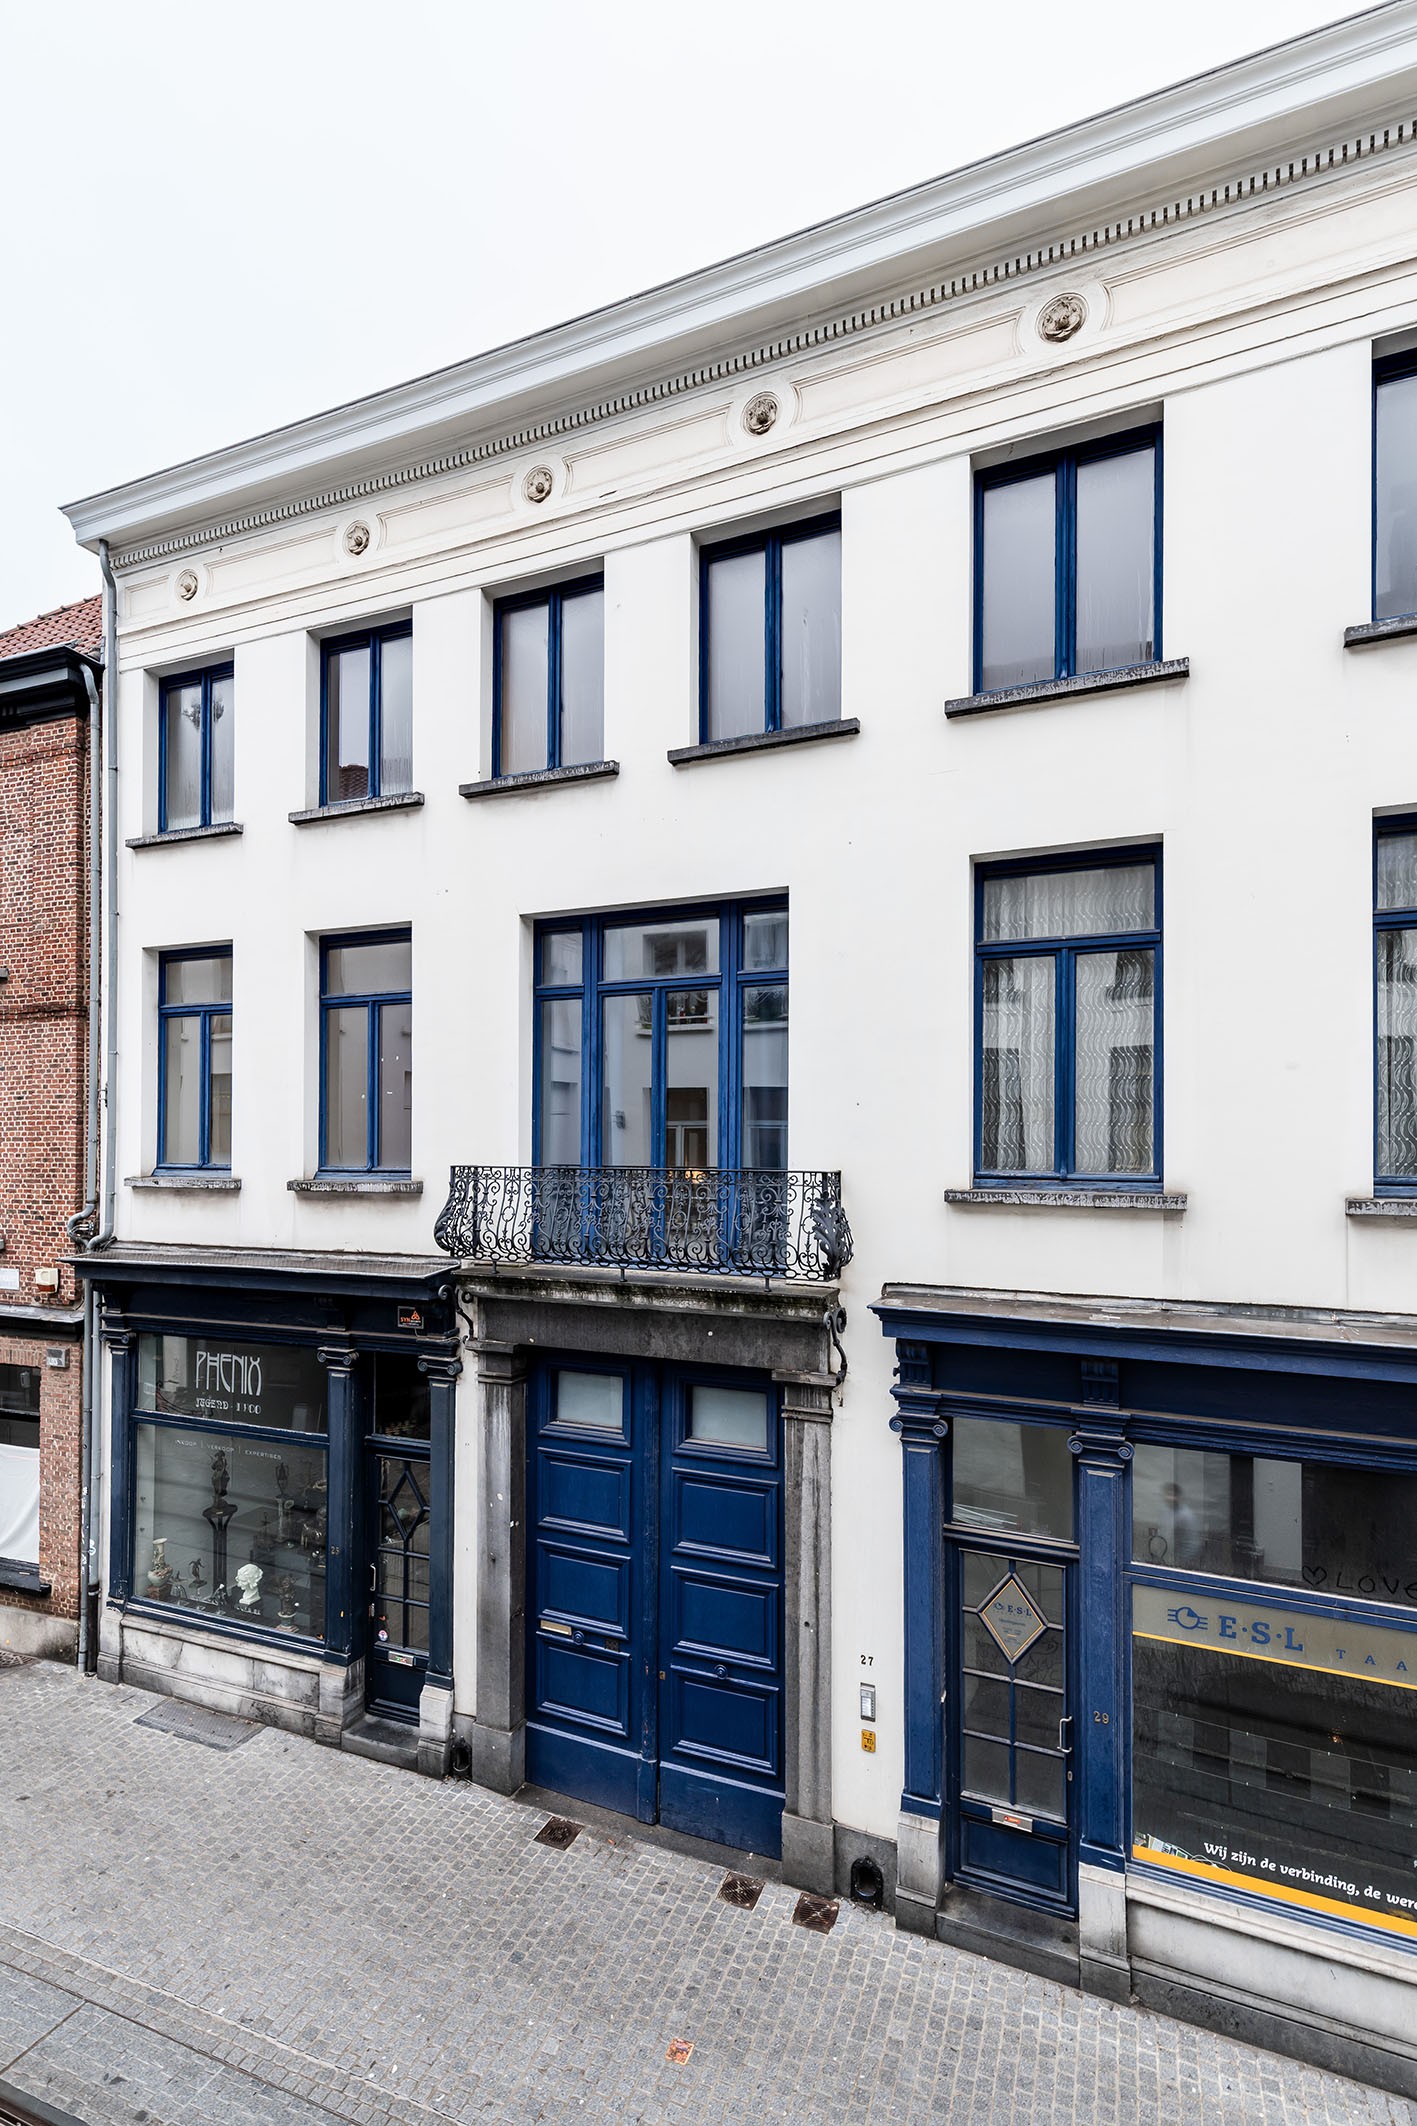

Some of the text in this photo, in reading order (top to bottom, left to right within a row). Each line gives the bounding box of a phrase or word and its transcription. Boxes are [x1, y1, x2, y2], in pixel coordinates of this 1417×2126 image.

[196, 1351, 262, 1396] PHENIX
[860, 1654, 875, 1667] 27
[1093, 1710, 1109, 1724] 29
[1203, 1842, 1228, 1860] Wij
[1230, 1850, 1256, 1867] zijn
[1260, 1857, 1277, 1871] de
[1279, 1864, 1360, 1896] verbinding,
[1363, 1885, 1381, 1900] de
